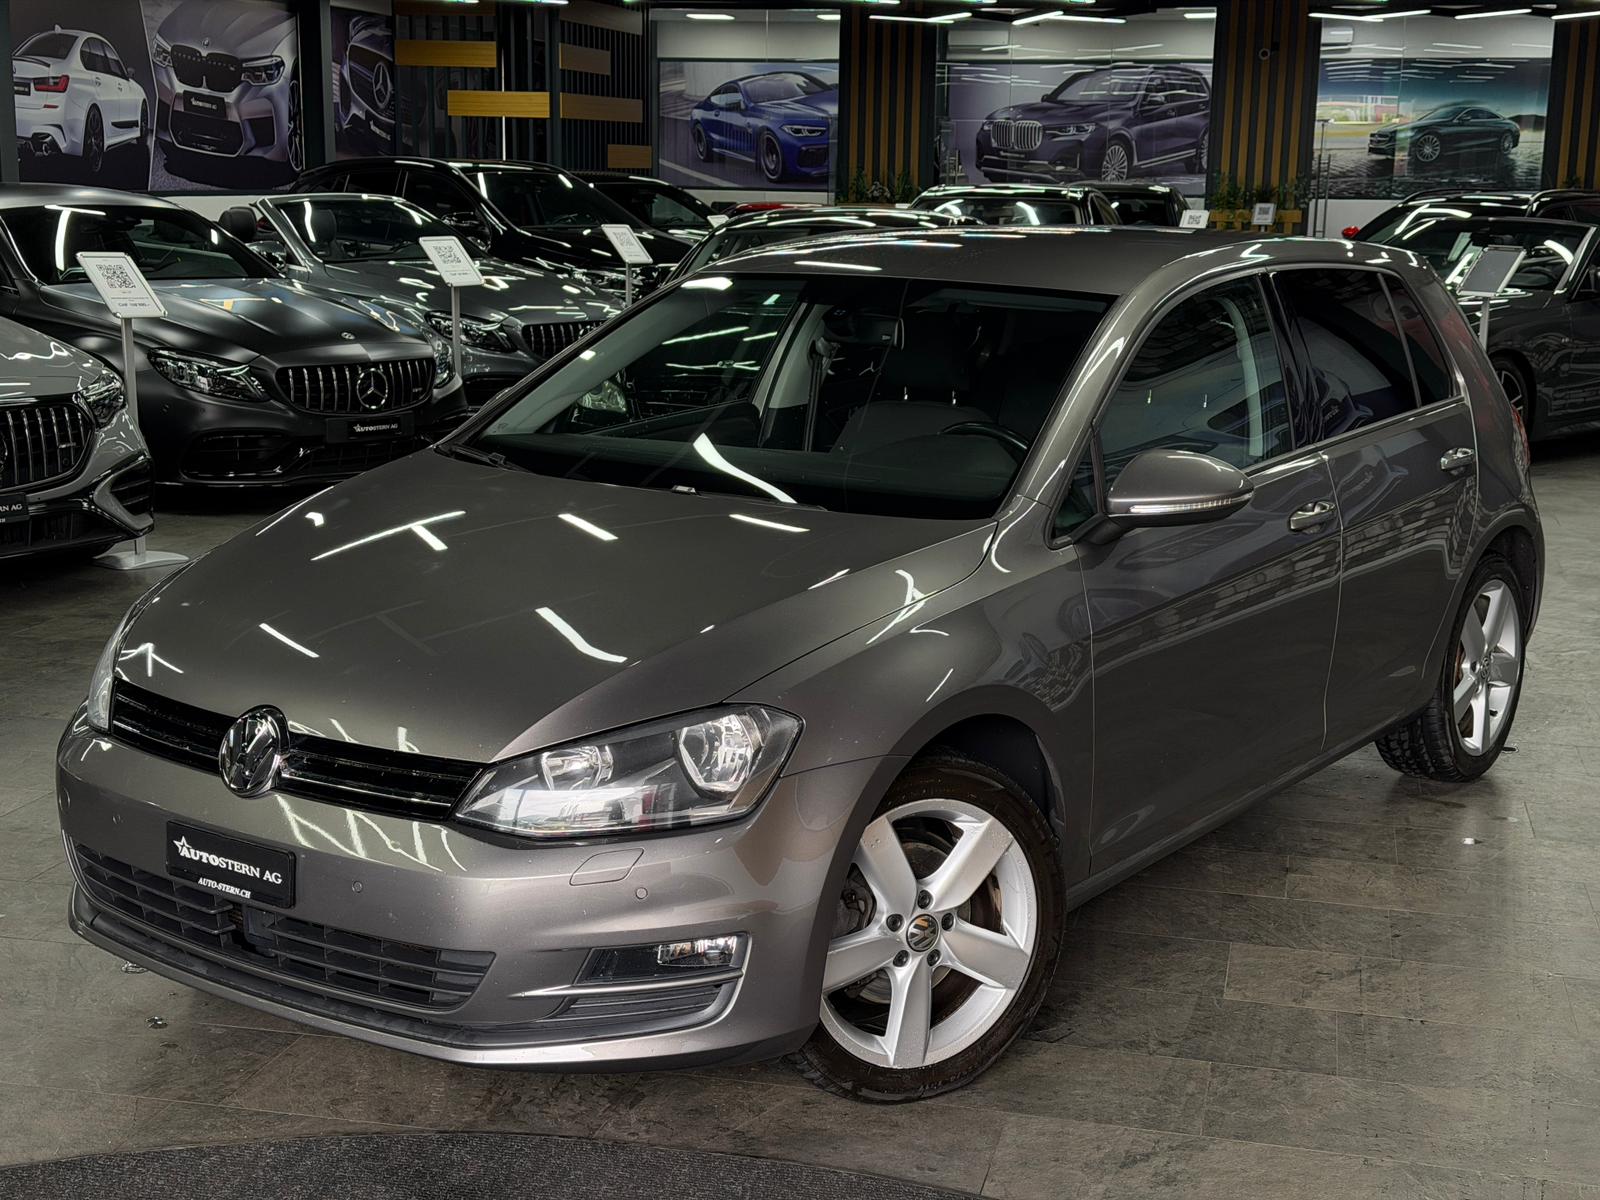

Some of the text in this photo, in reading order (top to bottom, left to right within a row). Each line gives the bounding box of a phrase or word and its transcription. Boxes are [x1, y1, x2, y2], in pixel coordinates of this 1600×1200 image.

[10, 503, 23, 511] AG
[180, 847, 283, 885] AUTOSTERN AG
[198, 877, 252, 898] AUTO-STERN.CH
